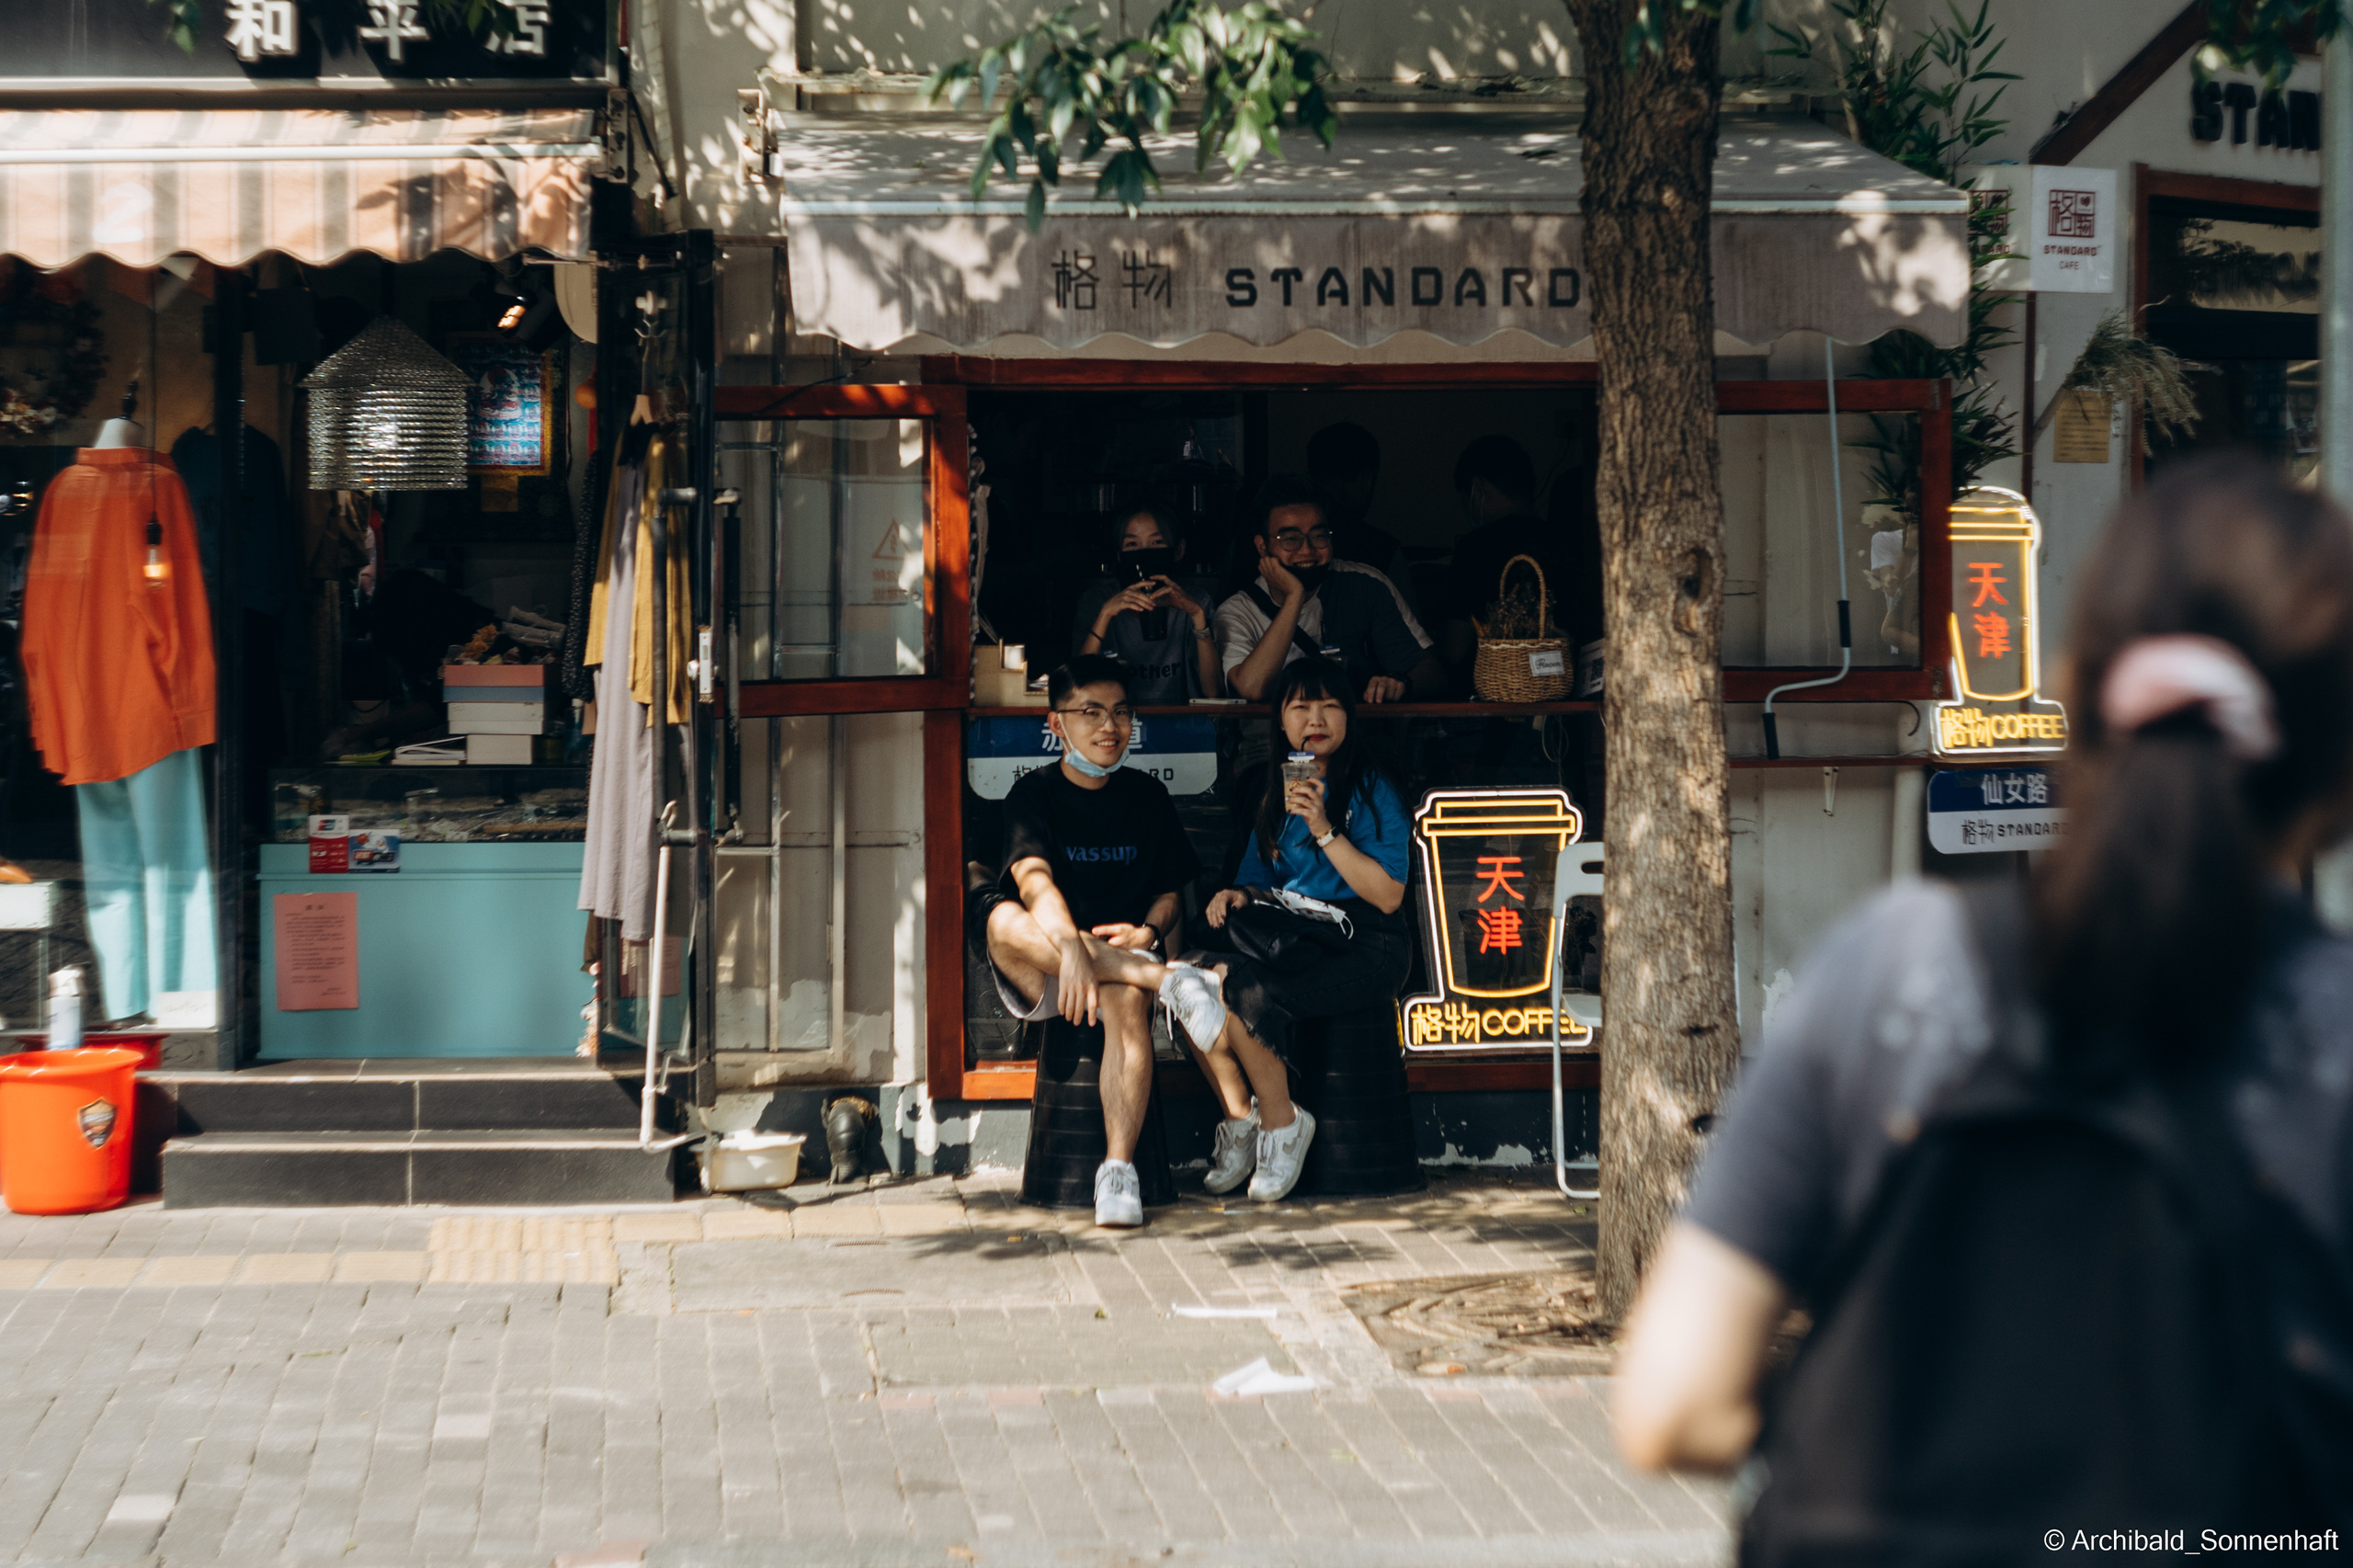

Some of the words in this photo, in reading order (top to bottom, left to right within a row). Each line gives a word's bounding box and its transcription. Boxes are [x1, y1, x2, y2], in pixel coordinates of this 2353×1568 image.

[1051, 250, 1170, 310] 格物
[1225, 267, 1581, 308] STANDARD
[2059, 261, 2080, 270] CAFE
[1968, 562, 2012, 658] 天津
[1982, 773, 2048, 805] 仙女路
[1476, 856, 1525, 955] 天津
